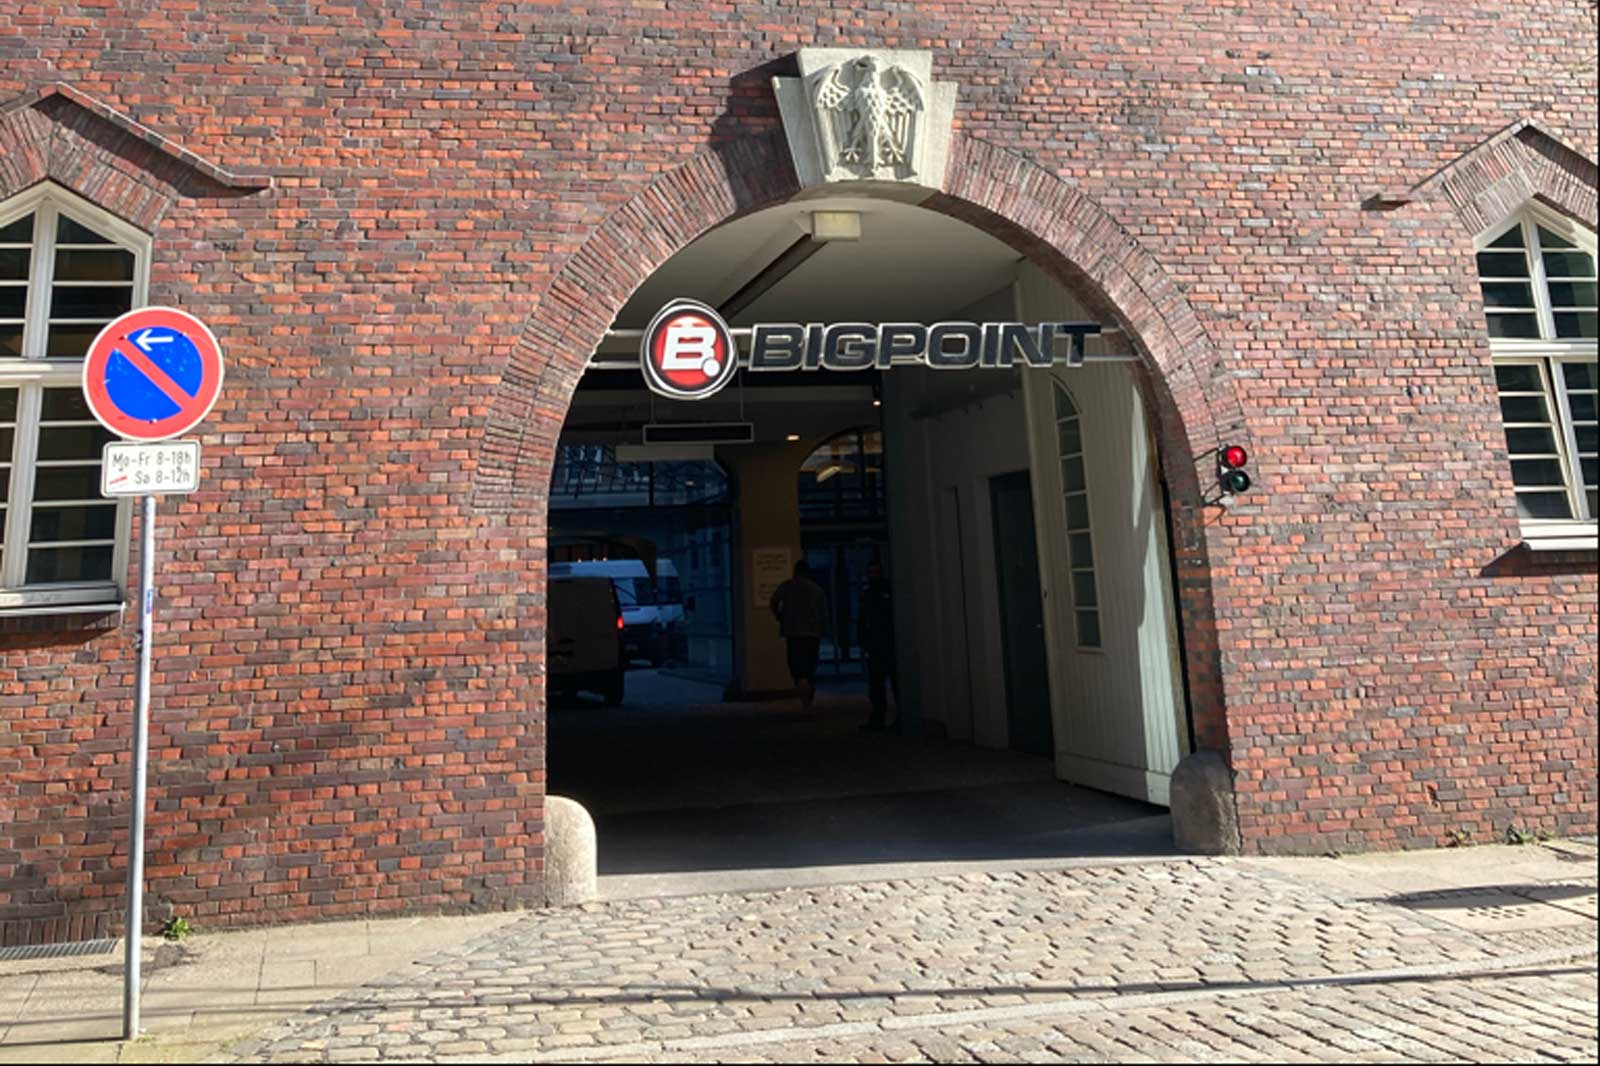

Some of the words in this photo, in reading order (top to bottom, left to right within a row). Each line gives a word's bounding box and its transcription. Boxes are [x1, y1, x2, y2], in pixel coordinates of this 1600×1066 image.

[749, 321, 1101, 371] BIGPOINT
[112, 452, 150, 467] Mo-Fr
[156, 451, 191, 465] 8-18h
[134, 471, 150, 485] Sa
[156, 469, 190, 484] 8-12h
